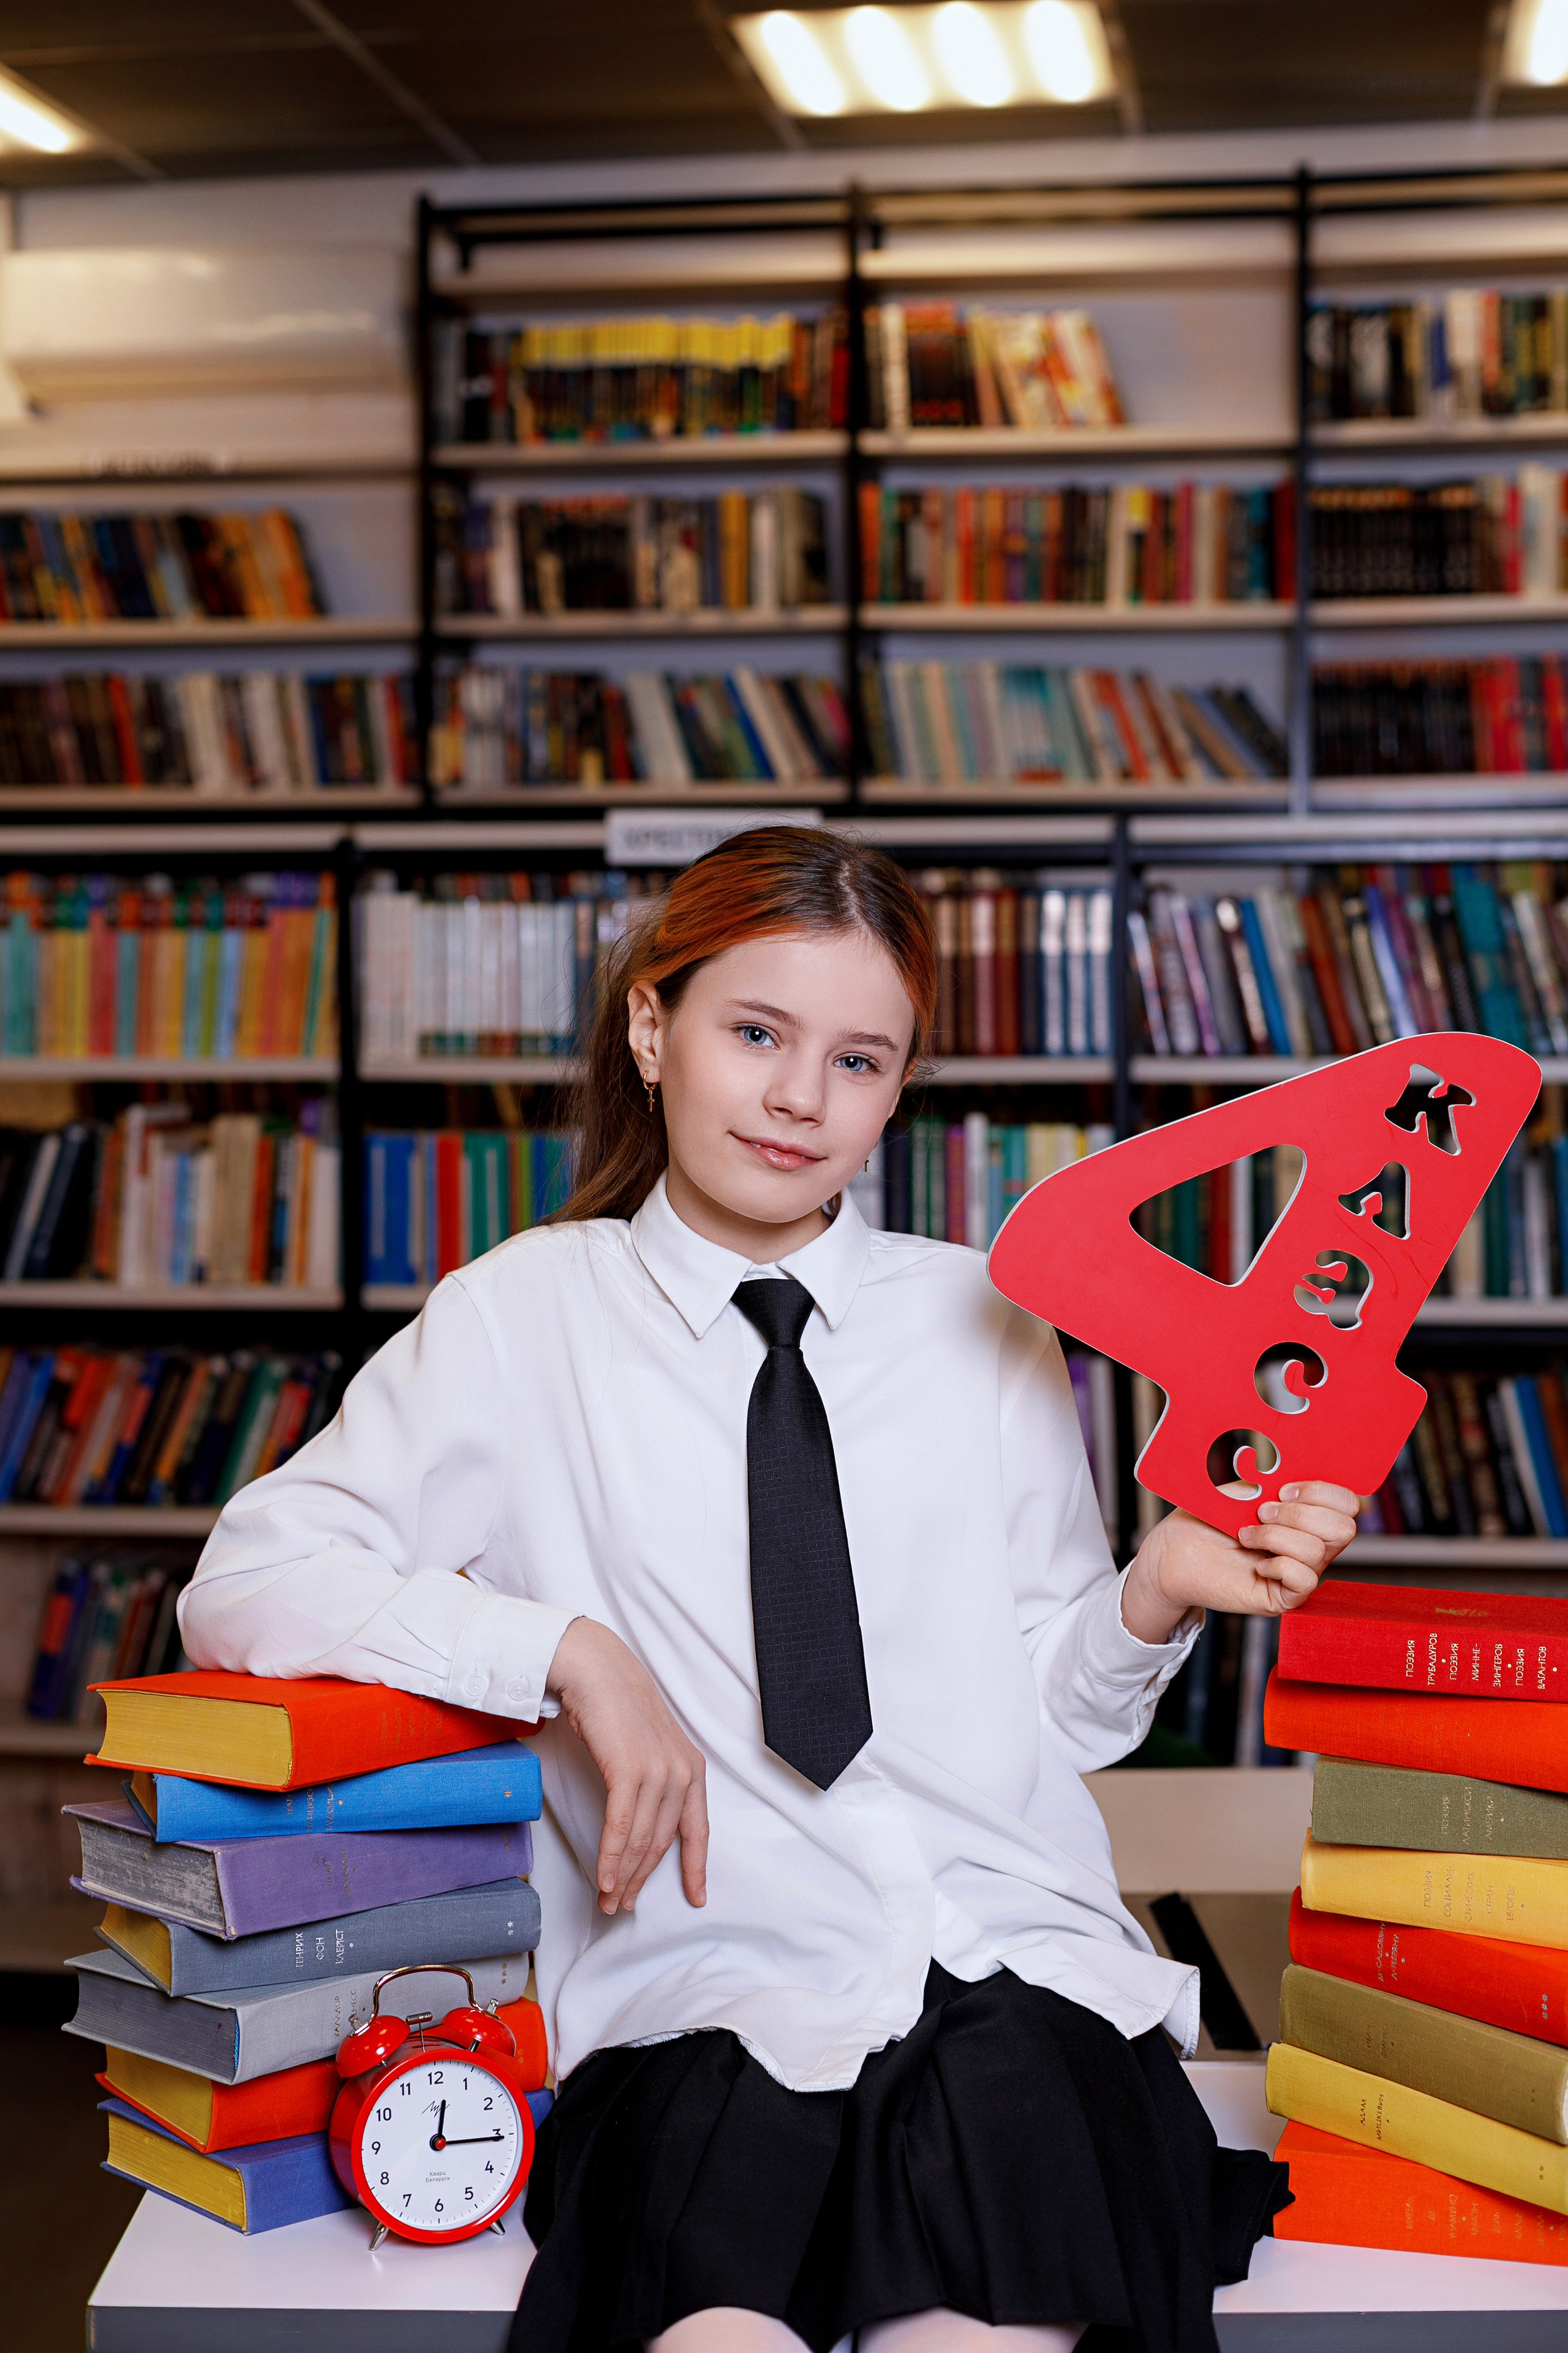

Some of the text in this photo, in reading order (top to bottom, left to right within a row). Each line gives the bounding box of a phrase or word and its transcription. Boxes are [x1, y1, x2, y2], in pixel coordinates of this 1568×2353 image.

[1406, 1639, 1415, 1677] ПОЭЗИЯ
[1427, 1633, 1438, 1686] ТРУБАДУРОВ
[1449, 1642, 1459, 1680] ПОЭЗИЯ
[1471, 1643, 1480, 1681] МИННЕ-
[1493, 1643, 1503, 1688] ЗИНГЕРОВ
[1515, 1648, 1525, 1686] ПОЭЗИЯ
[1537, 1645, 1547, 1690] ВАГАНТОВ
[1441, 1796, 1450, 1834] ПОЭЗИЯ
[1423, 1870, 1433, 1908] ПОЭЗИЯ
[1464, 1871, 1475, 1922] СТИЧЕСКИХ
[1486, 1884, 1494, 1914] СТРАН
[1506, 1886, 1515, 1921] ЕВРОПЫ
[295, 1932, 304, 1968] ГЕНРИХ
[315, 1937, 325, 1960] ФОН
[400, 2082, 411, 2096] 11
[428, 2071, 444, 2086] 12
[463, 2077, 468, 2090] 1
[376, 2107, 391, 2121] 10
[483, 2097, 493, 2111] 2
[1376, 2094, 1384, 2141] МИЦКЕВИЧ
[371, 2141, 381, 2155] 9
[492, 2129, 502, 2142] 3
[380, 2171, 390, 2185] 8
[484, 2161, 494, 2174] 4
[403, 2194, 412, 2208] 7
[434, 2198, 444, 2212] 6
[464, 2186, 473, 2200] 5
